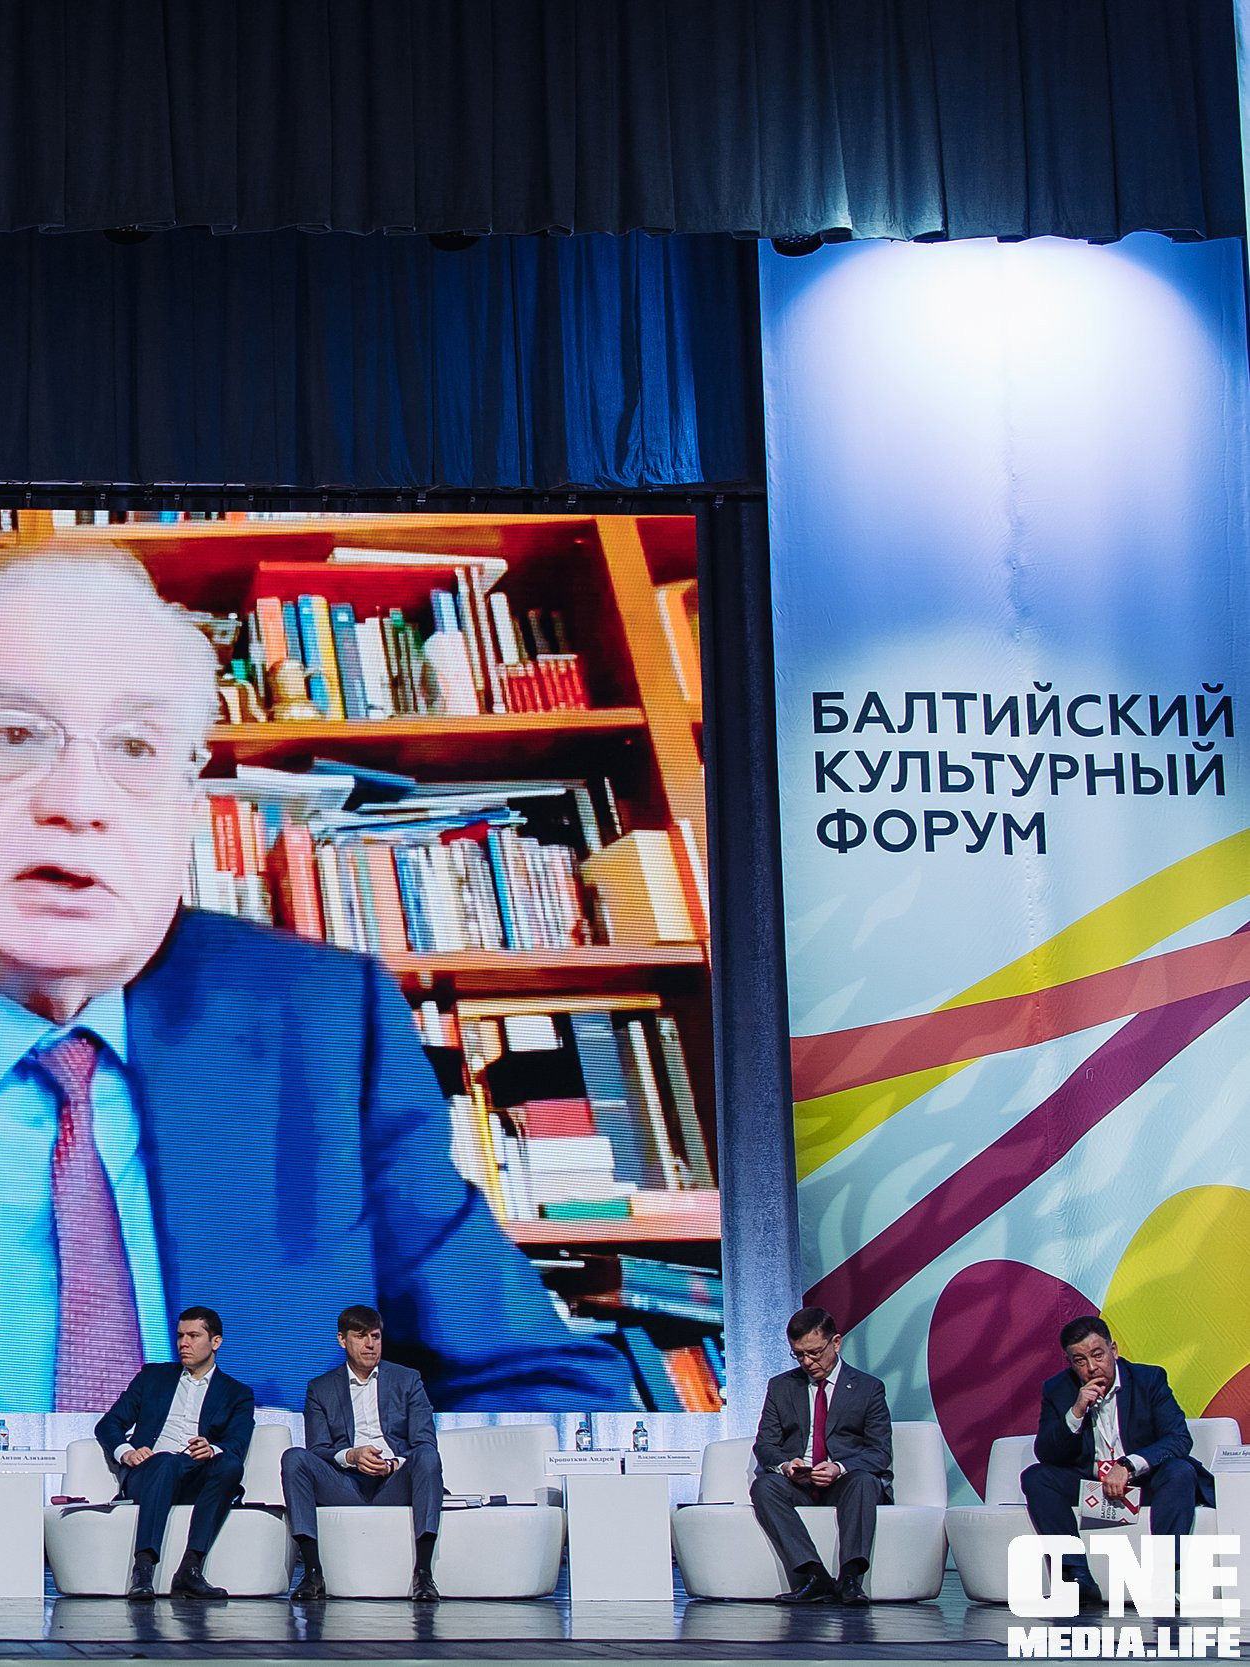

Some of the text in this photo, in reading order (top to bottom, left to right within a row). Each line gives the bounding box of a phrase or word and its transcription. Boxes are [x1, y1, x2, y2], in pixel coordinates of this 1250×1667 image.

[812, 681, 1235, 738] БАЛТИЙСКИЙ
[814, 741, 1227, 797] КУЛЬТУРНЫЙ
[816, 808, 1047, 855] ФОРУМ
